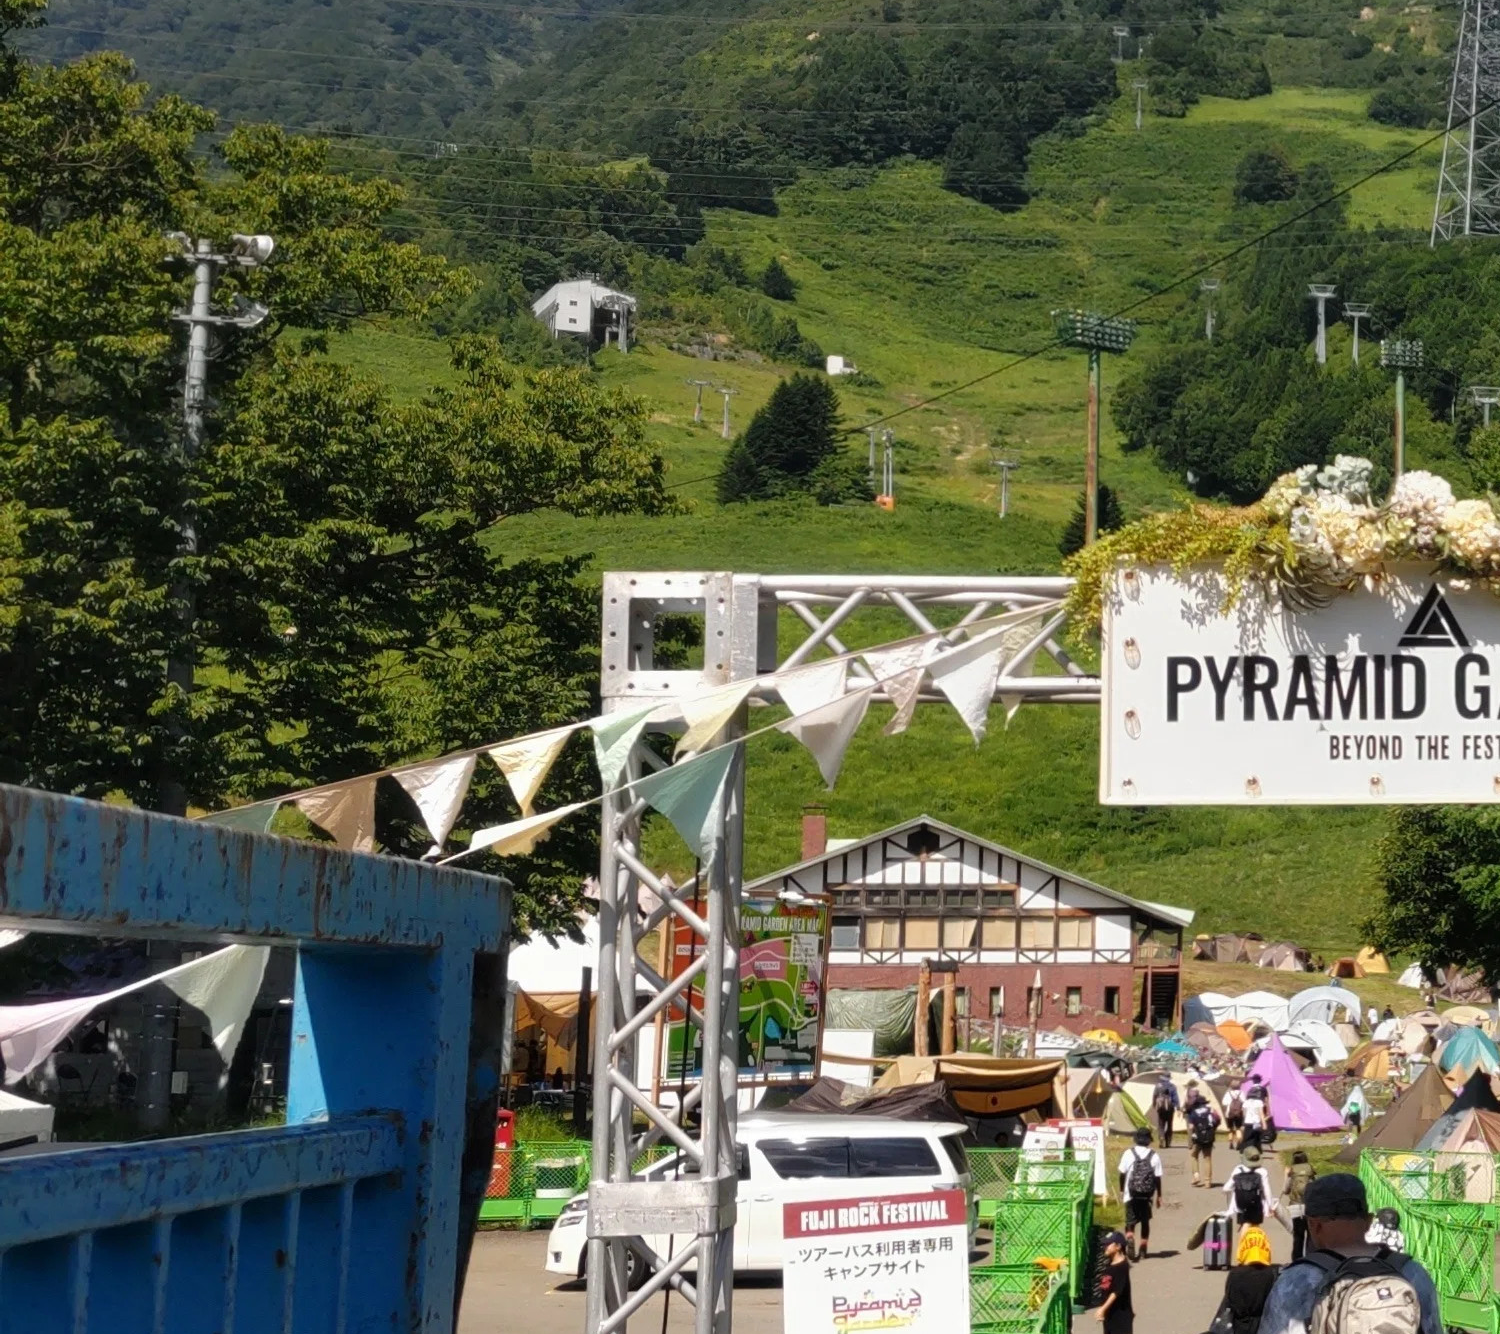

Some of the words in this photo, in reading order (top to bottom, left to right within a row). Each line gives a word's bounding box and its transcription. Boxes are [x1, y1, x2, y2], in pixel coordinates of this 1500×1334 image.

[1165, 654, 1427, 722] PYRAMID
[1329, 734, 1403, 761] BEYOND
[1416, 734, 1451, 760] THE
[801, 1209, 835, 1231] FUJI
[838, 1206, 880, 1228] ROCK
[882, 1199, 949, 1224] FESTIVAL
[799, 1236, 954, 1264] ツアーバス利用者専用
[824, 1259, 926, 1282] キャンプサイト
